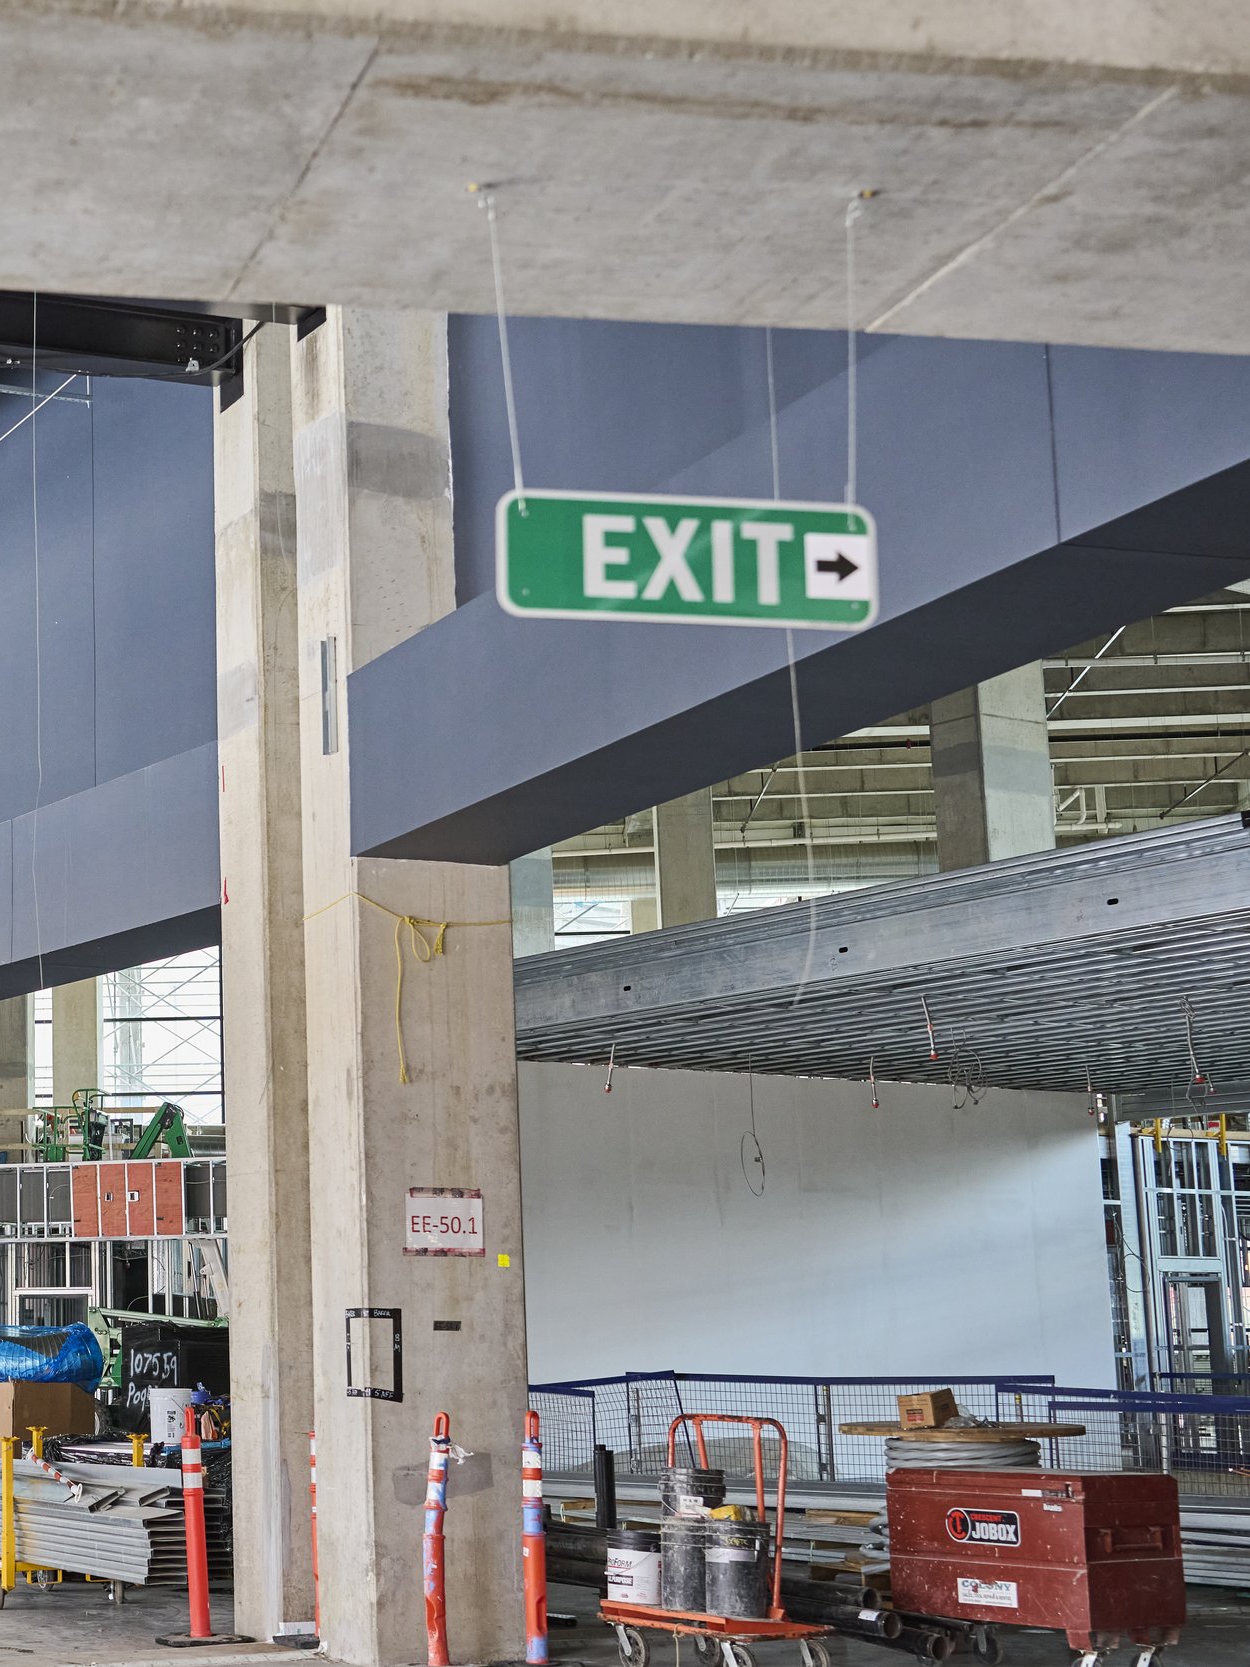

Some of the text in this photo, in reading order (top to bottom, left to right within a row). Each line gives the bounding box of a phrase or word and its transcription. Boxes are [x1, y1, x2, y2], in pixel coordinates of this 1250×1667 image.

[582, 513, 794, 605] EXIT
[411, 1215, 478, 1234] EE-50.1
[970, 1513, 1003, 1522] CRESCENT
[971, 1521, 1017, 1542] JOBOX
[961, 1580, 1011, 1591] COLONY
